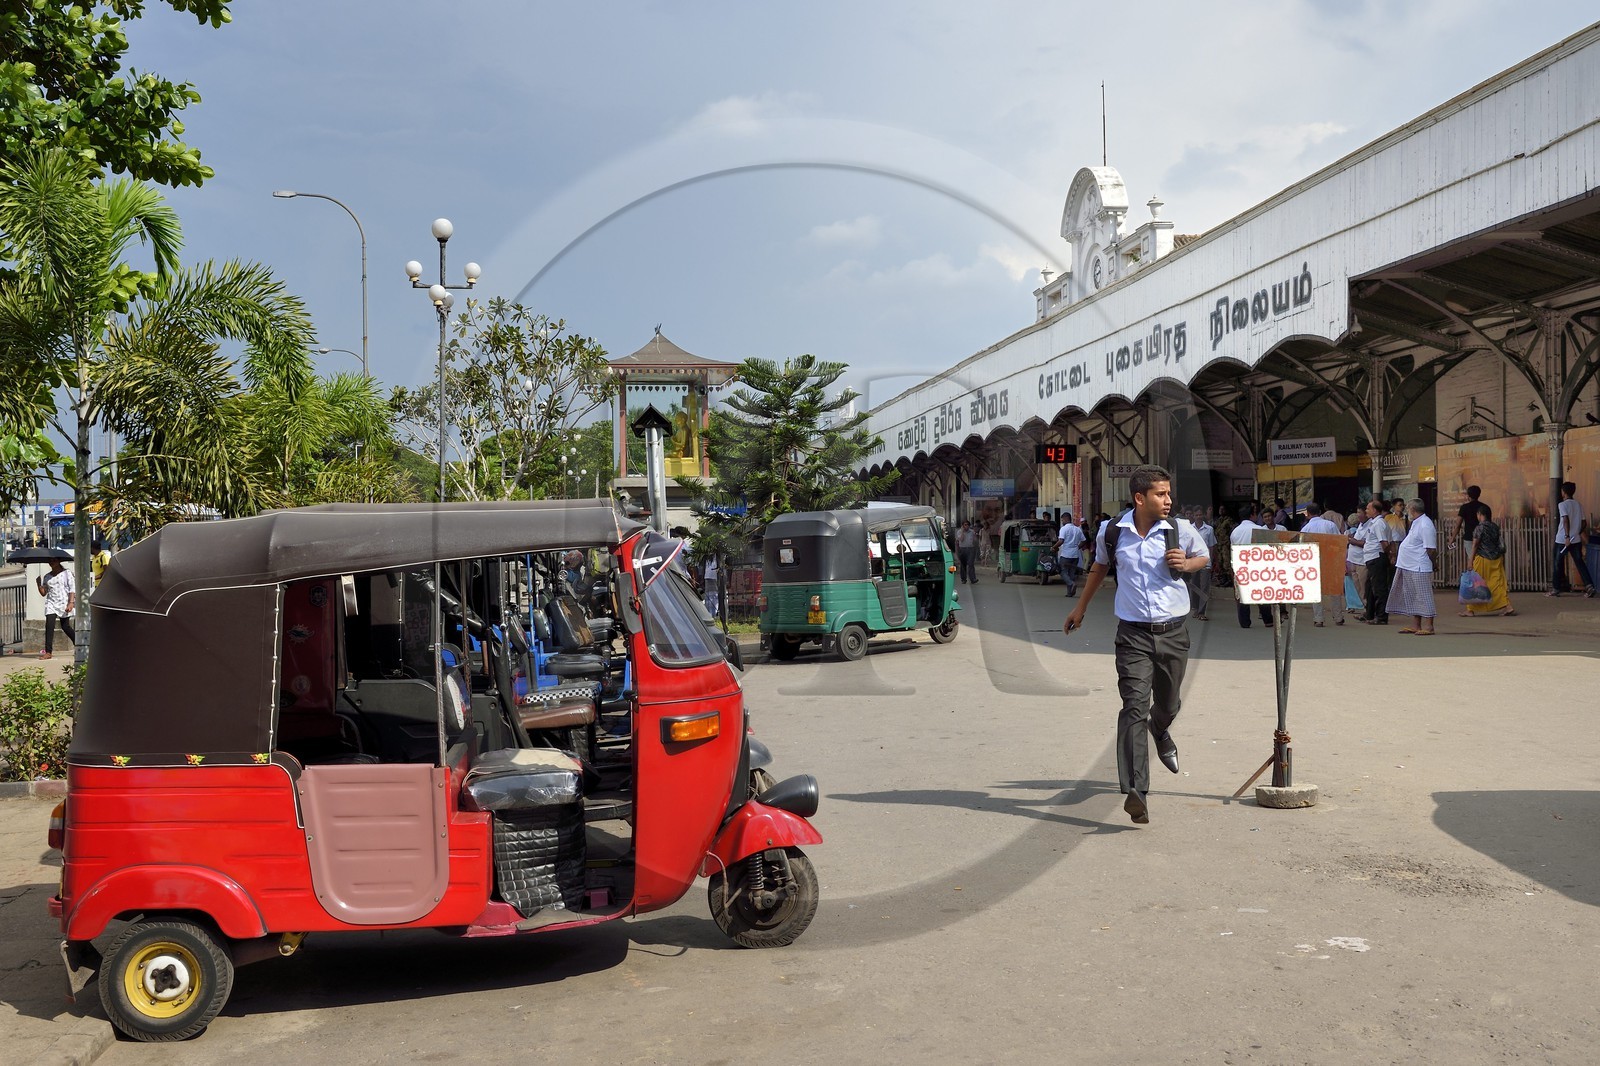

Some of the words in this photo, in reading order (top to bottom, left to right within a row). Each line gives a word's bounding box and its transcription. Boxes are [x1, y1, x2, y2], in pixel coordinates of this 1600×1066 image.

[1038, 361, 1091, 400] கோட்டை
[1105, 320, 1187, 383] புகையிரத
[1209, 261, 1313, 351] நிலையம்
[1304, 441, 1327, 449] TOURIST
[1047, 447, 1066, 462] 43
[1273, 453, 1310, 461] INFORMATION
[1311, 451, 1333, 459] SERVICE
[1383, 451, 1411, 466] ailway
[1294, 566, 1318, 581] රථ
[1250, 585, 1305, 601] පමණයි
